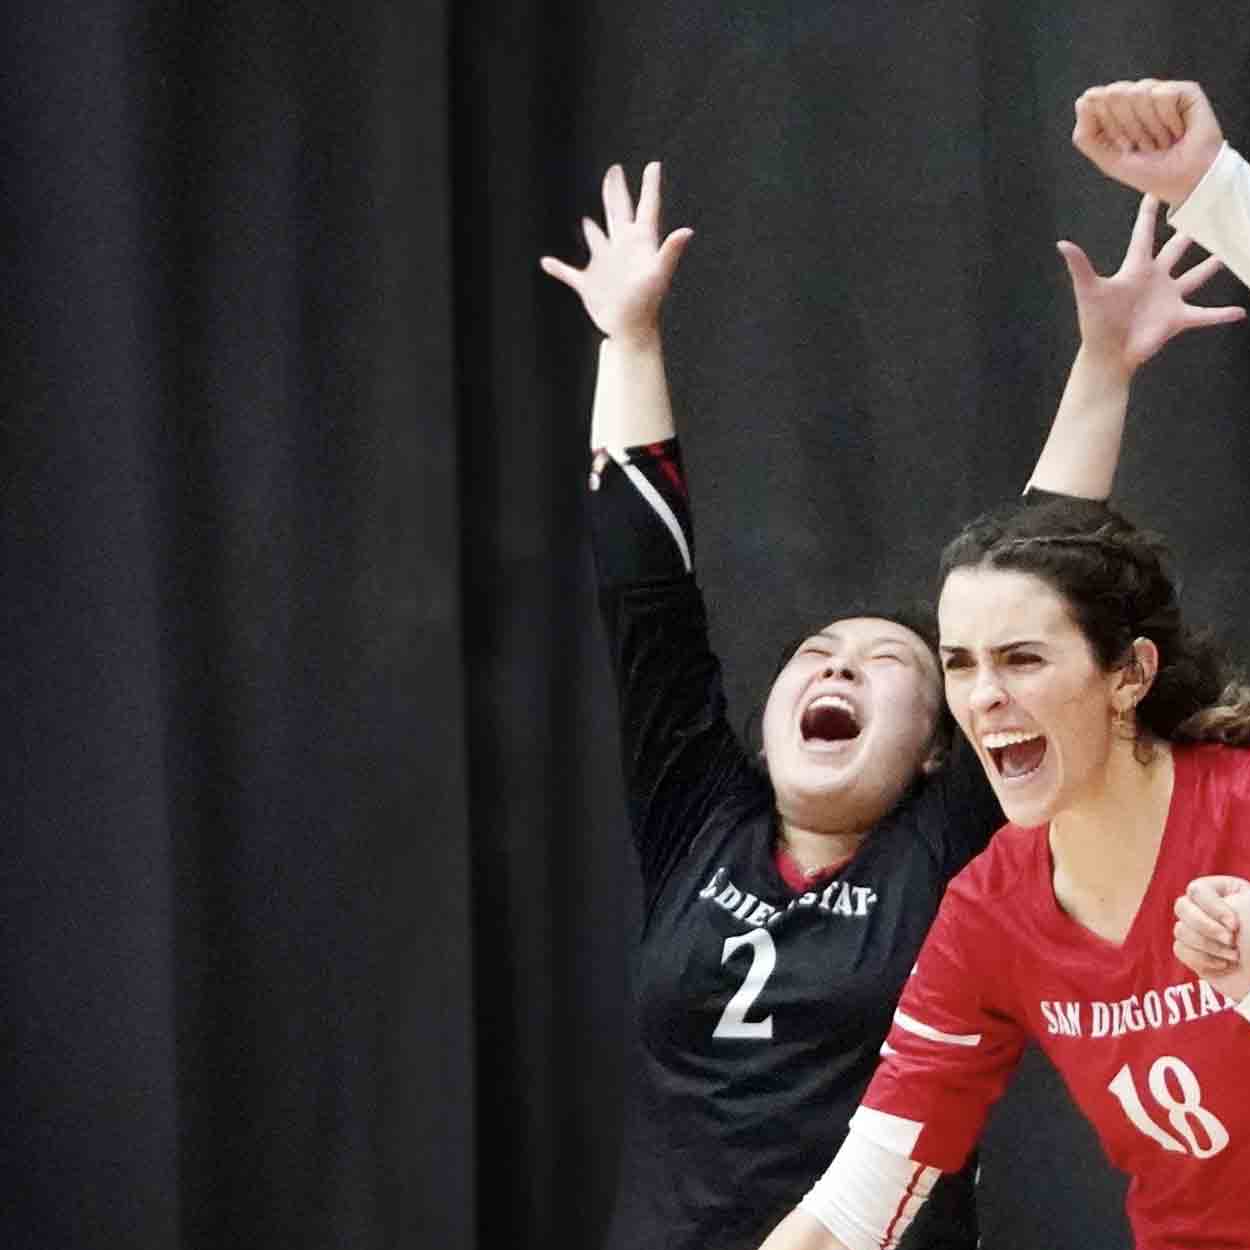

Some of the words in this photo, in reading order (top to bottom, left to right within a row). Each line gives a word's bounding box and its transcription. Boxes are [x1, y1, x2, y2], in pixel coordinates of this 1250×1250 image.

[715, 881, 794, 927] DIE
[713, 928, 776, 1038] 2
[1040, 1000, 1083, 1037] SAN
[1163, 979, 1235, 1025] STA
[1107, 1055, 1230, 1158] 18
